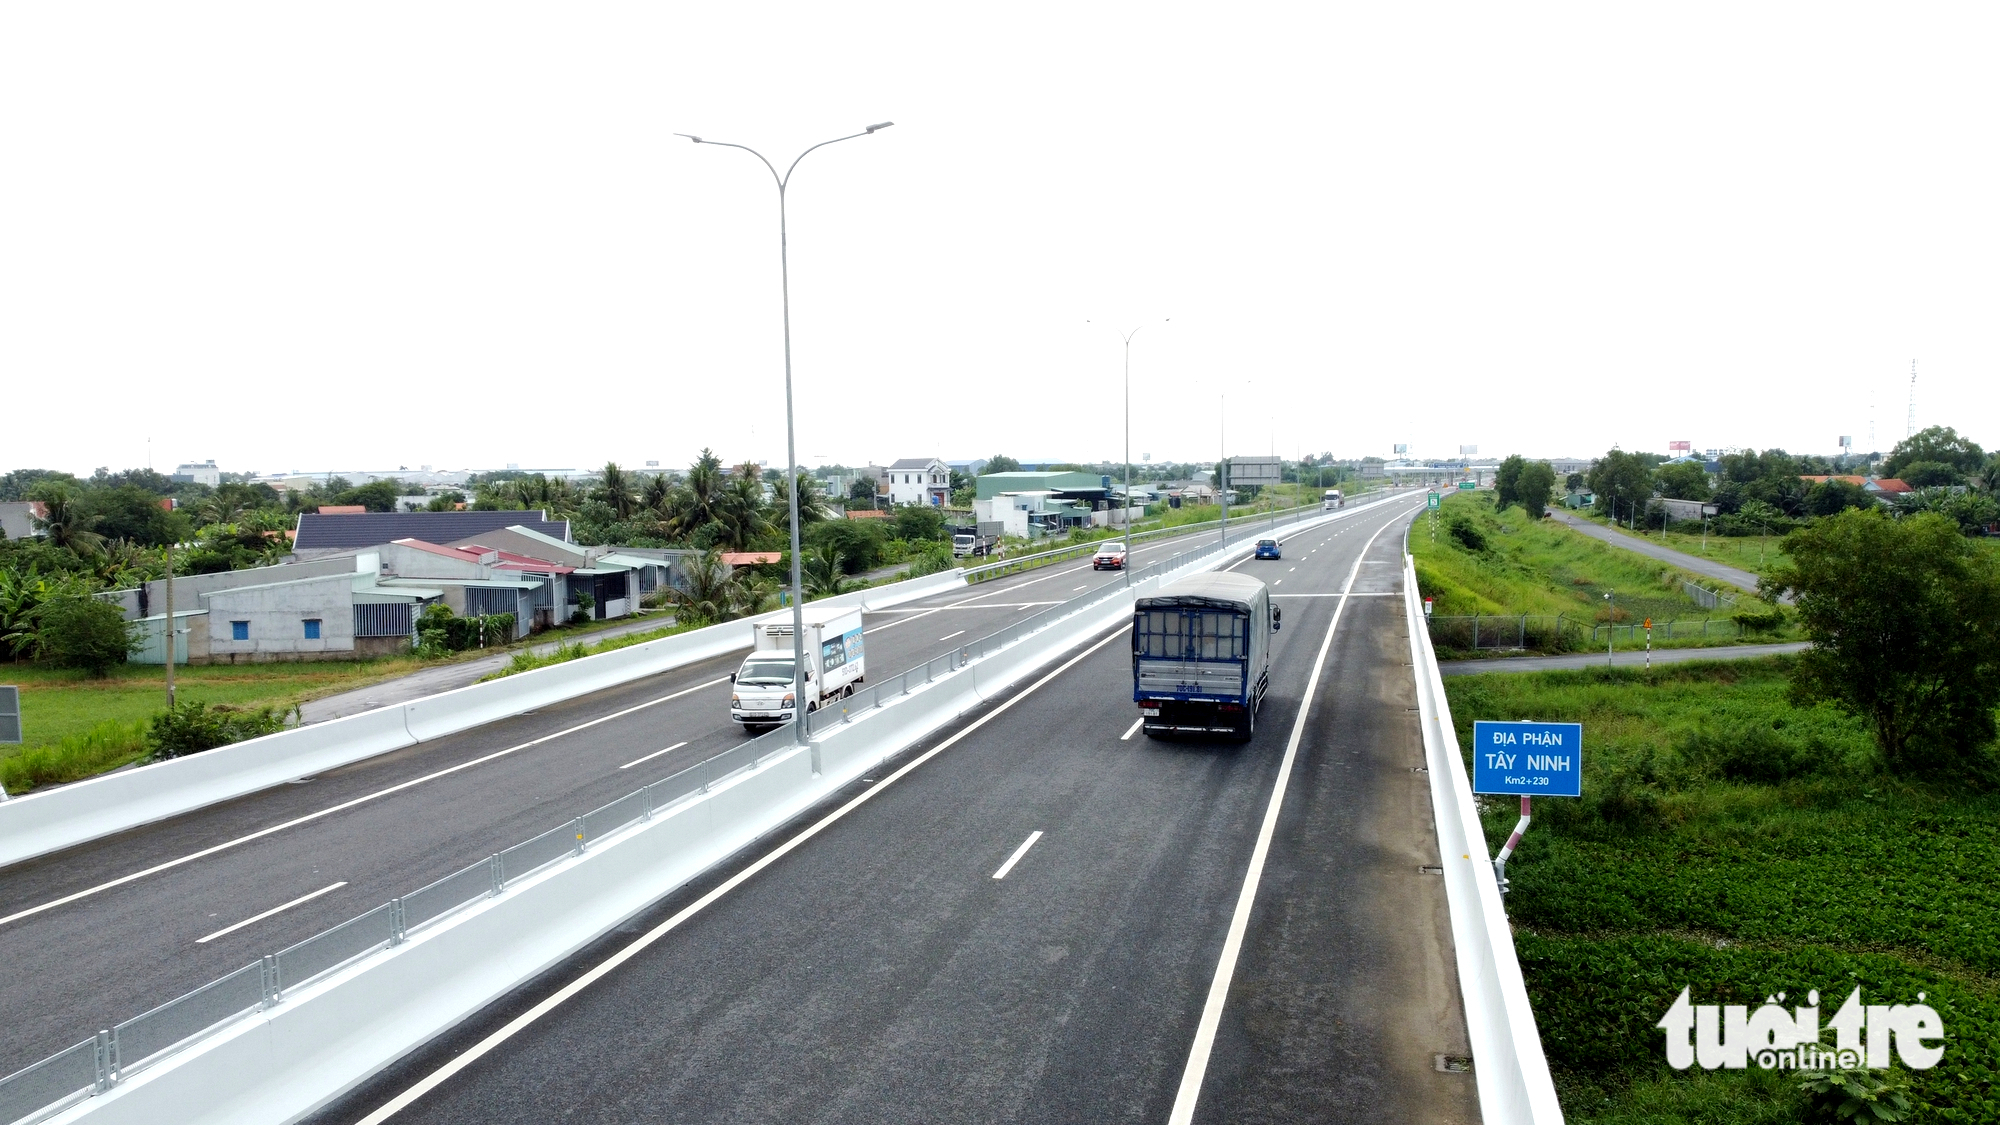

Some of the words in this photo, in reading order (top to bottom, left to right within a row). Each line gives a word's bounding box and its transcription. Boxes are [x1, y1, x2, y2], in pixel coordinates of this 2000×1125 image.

[1493, 731, 1517, 747] ĐỊA
[1523, 730, 1562, 748] PHẬN
[1485, 750, 1517, 770] TÂY
[1527, 754, 1570, 772] NINH
[1505, 775, 1549, 786] Km2+230
